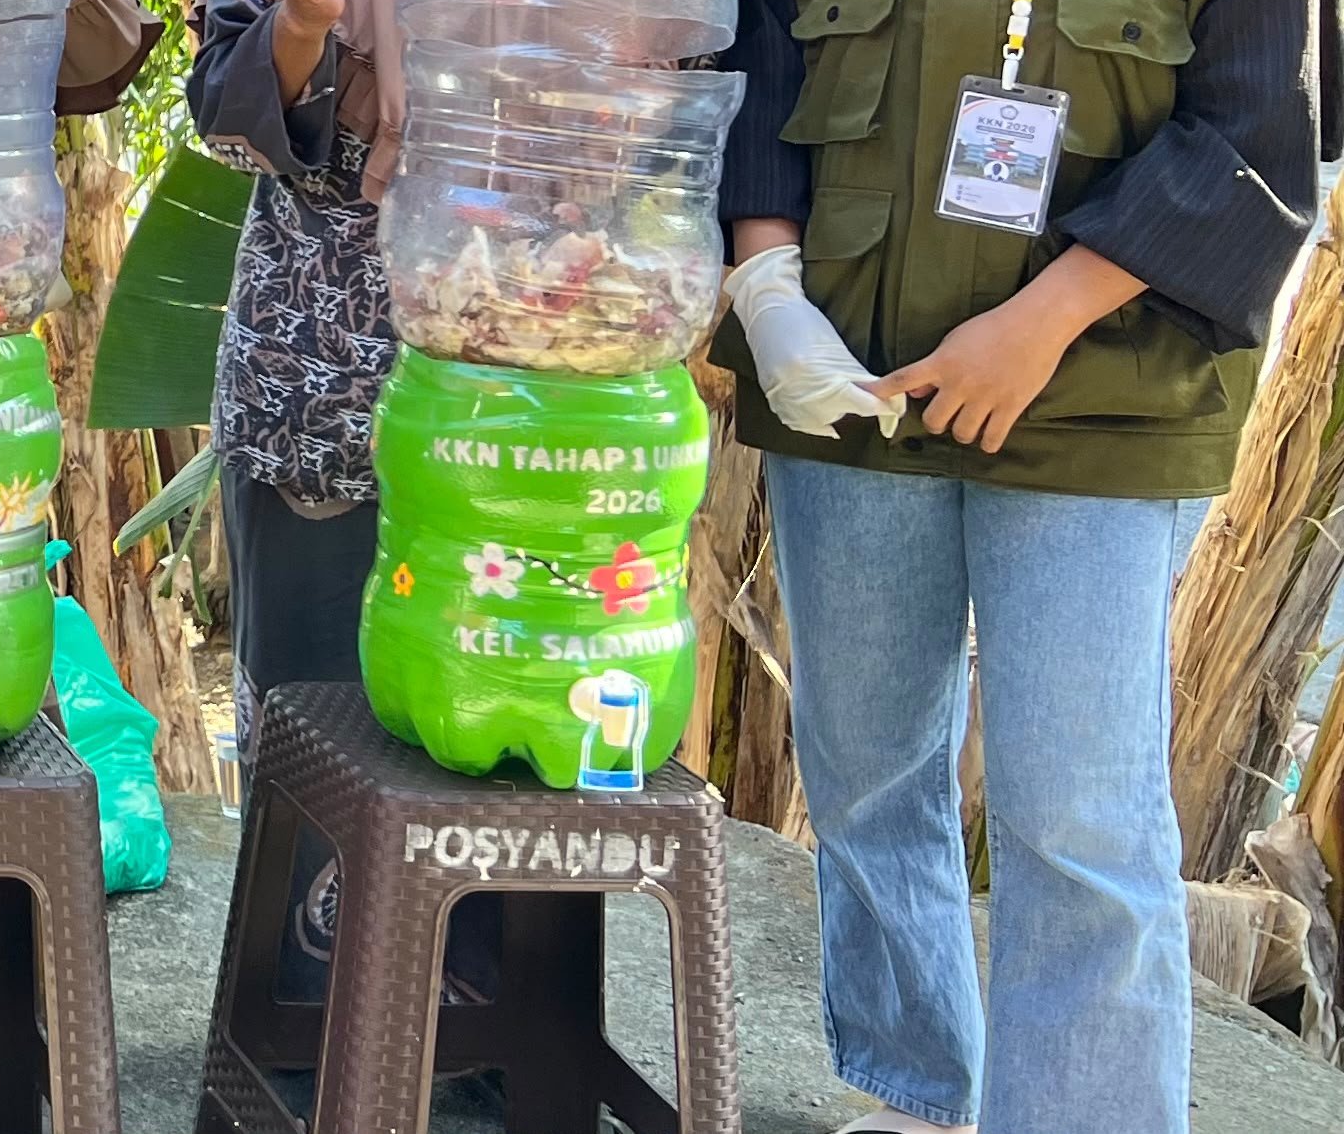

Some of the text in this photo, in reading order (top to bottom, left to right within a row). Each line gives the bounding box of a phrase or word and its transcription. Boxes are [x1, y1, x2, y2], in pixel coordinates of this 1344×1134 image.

[978, 116, 1003, 127] KKN
[433, 437, 500, 469] KKN
[509, 444, 625, 472] TAHAP
[631, 446, 648, 472] 1
[585, 488, 663, 515] 2026
[458, 625, 531, 659] KEL.
[404, 823, 678, 877] POSYANDU
